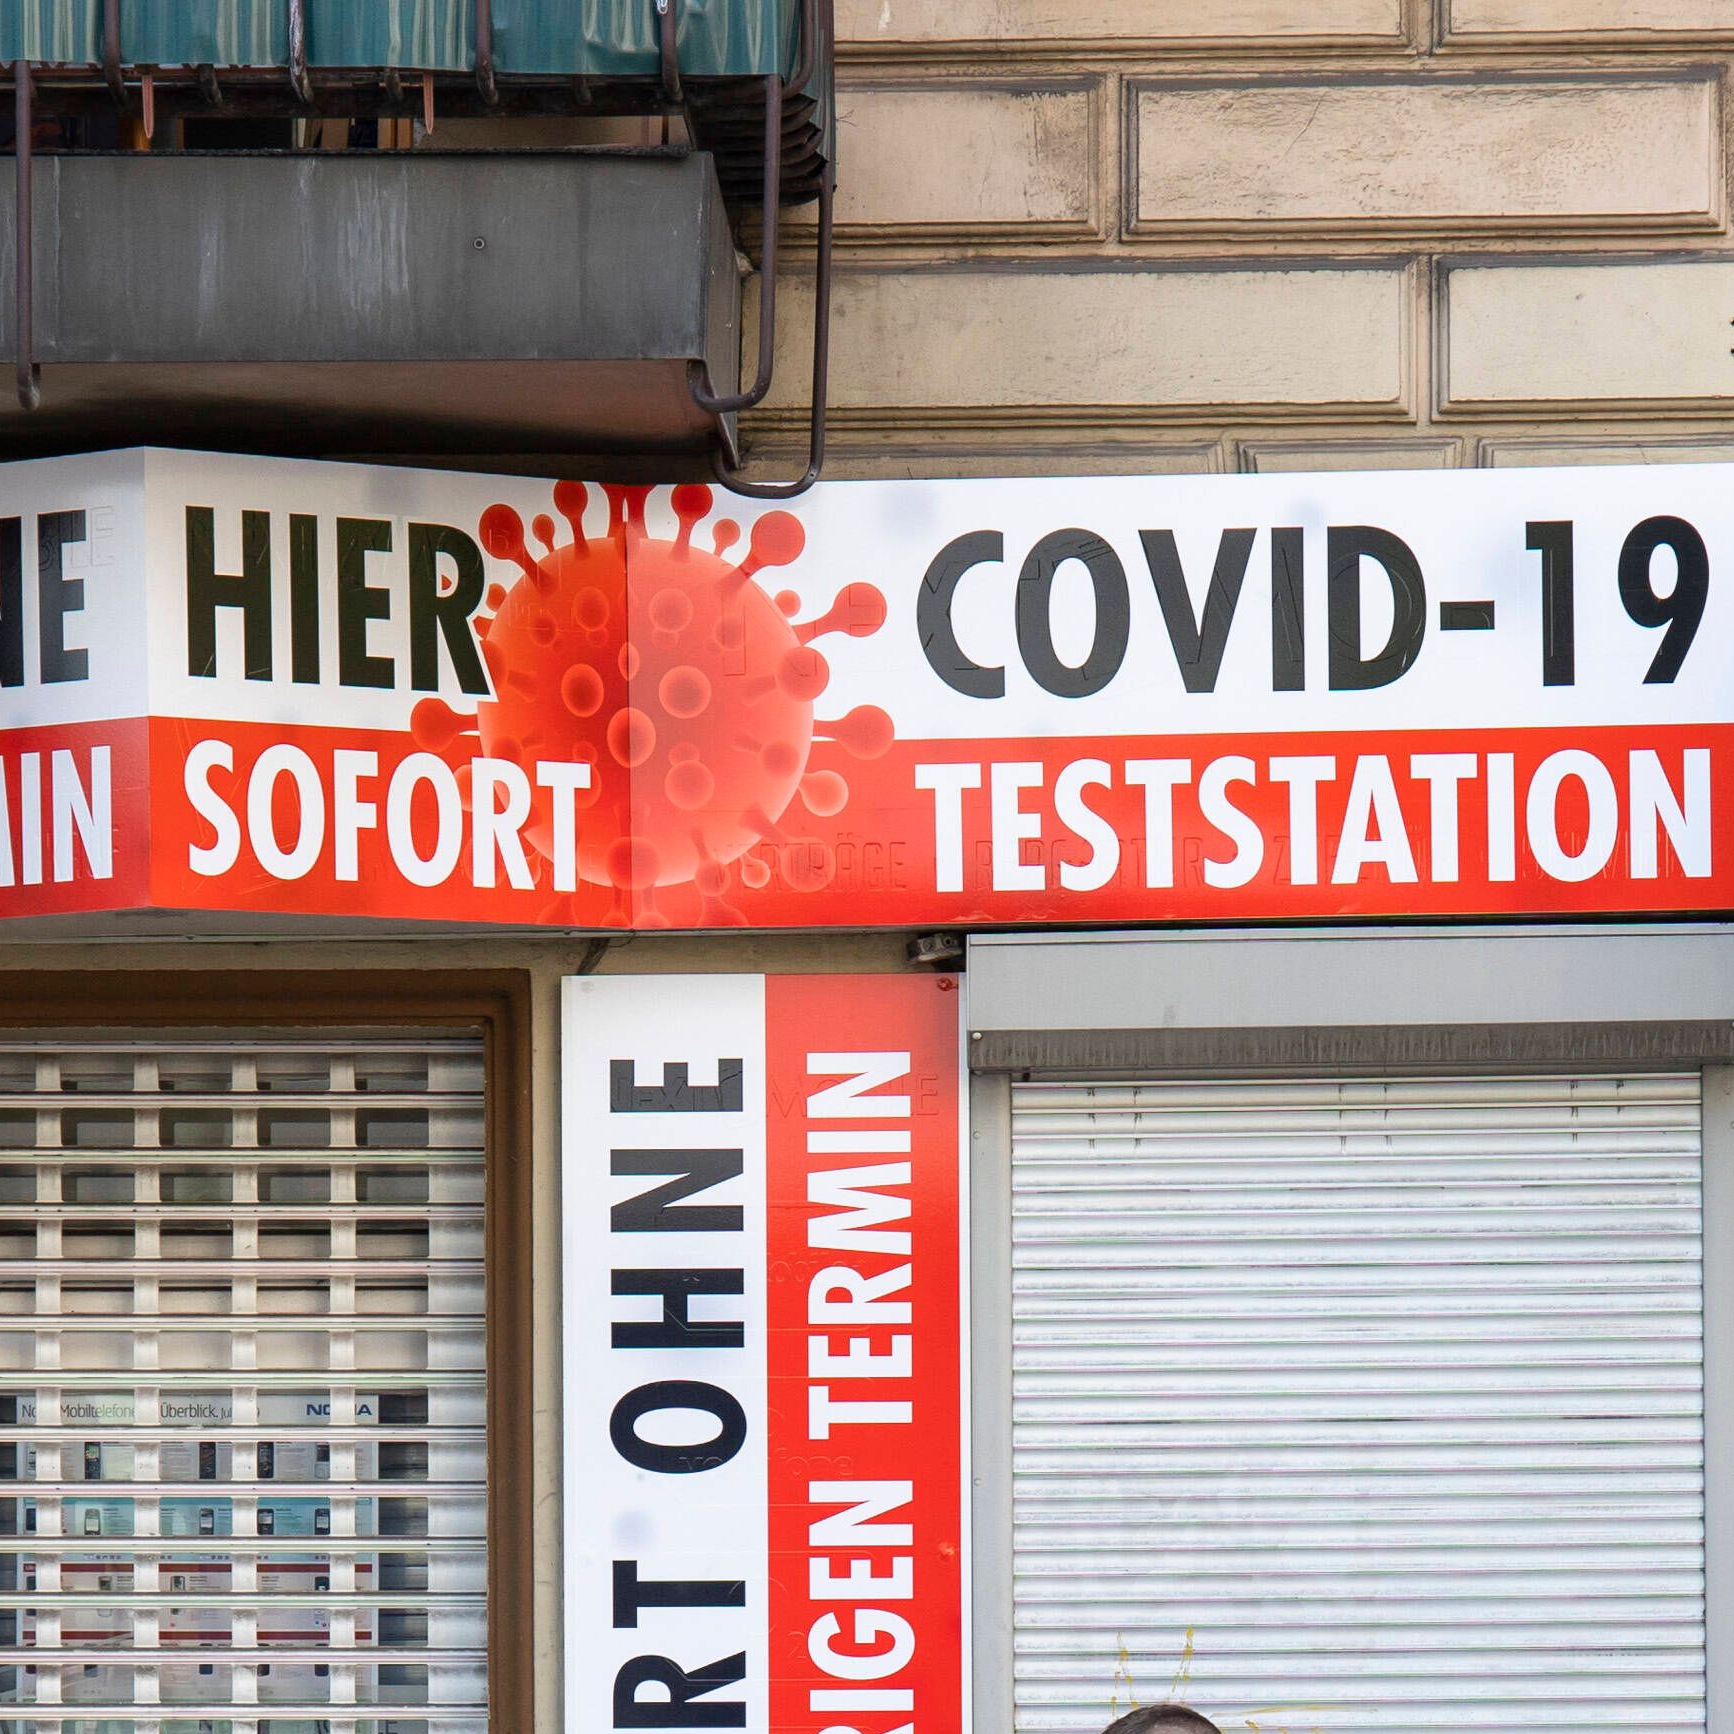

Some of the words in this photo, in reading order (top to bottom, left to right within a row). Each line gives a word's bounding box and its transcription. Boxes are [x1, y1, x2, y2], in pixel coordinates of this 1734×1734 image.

[185, 506, 490, 696] HIER
[916, 514, 1710, 699] COVID-19
[184, 740, 591, 893] SOFORT
[916, 748, 1713, 892] TESTSTATION
[609, 1058, 747, 1474] OHNE
[806, 1051, 913, 1440] TERMIN
